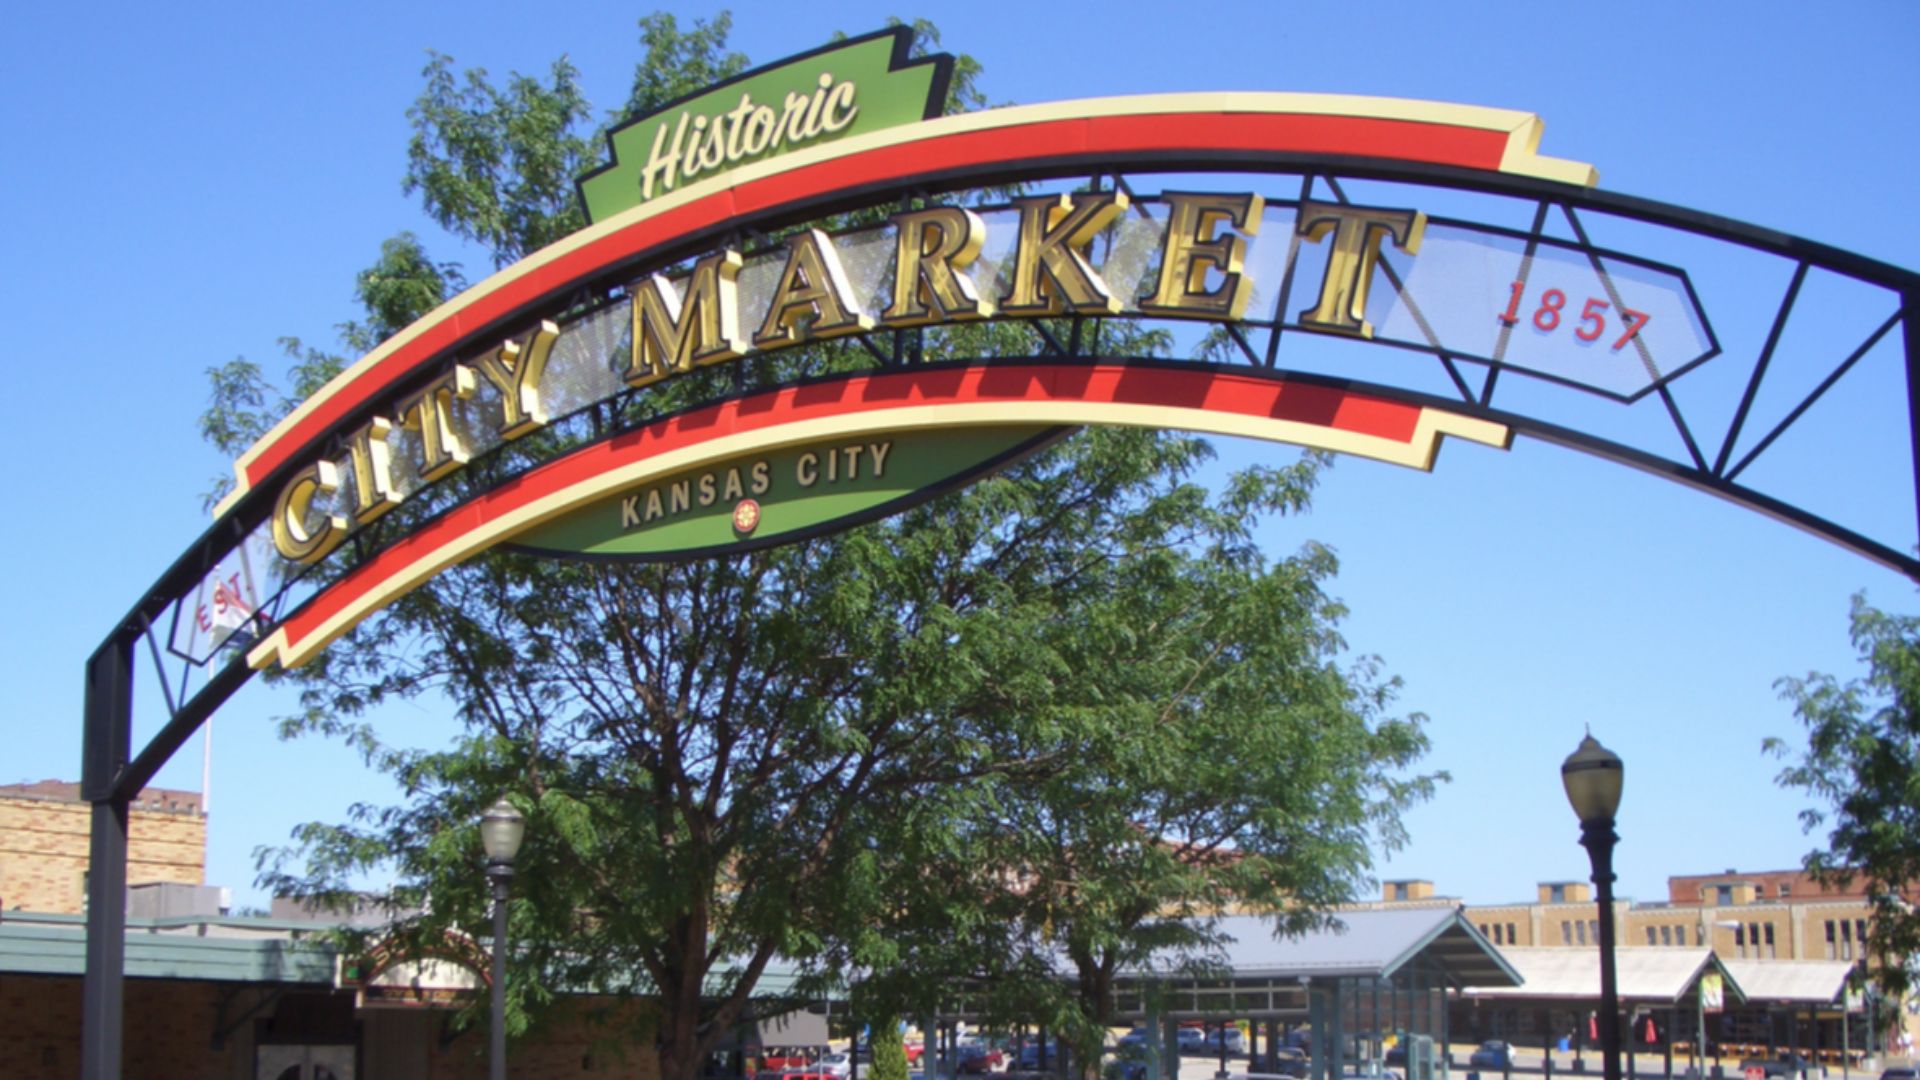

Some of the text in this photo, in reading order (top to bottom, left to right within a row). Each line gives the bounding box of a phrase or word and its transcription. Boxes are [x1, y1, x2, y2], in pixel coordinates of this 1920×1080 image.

[640, 72, 860, 200] Historic
[1498, 280, 1651, 351] 1857
[271, 189, 1428, 564] CITY MARKET
[620, 442, 892, 529] KANSAS CITY
